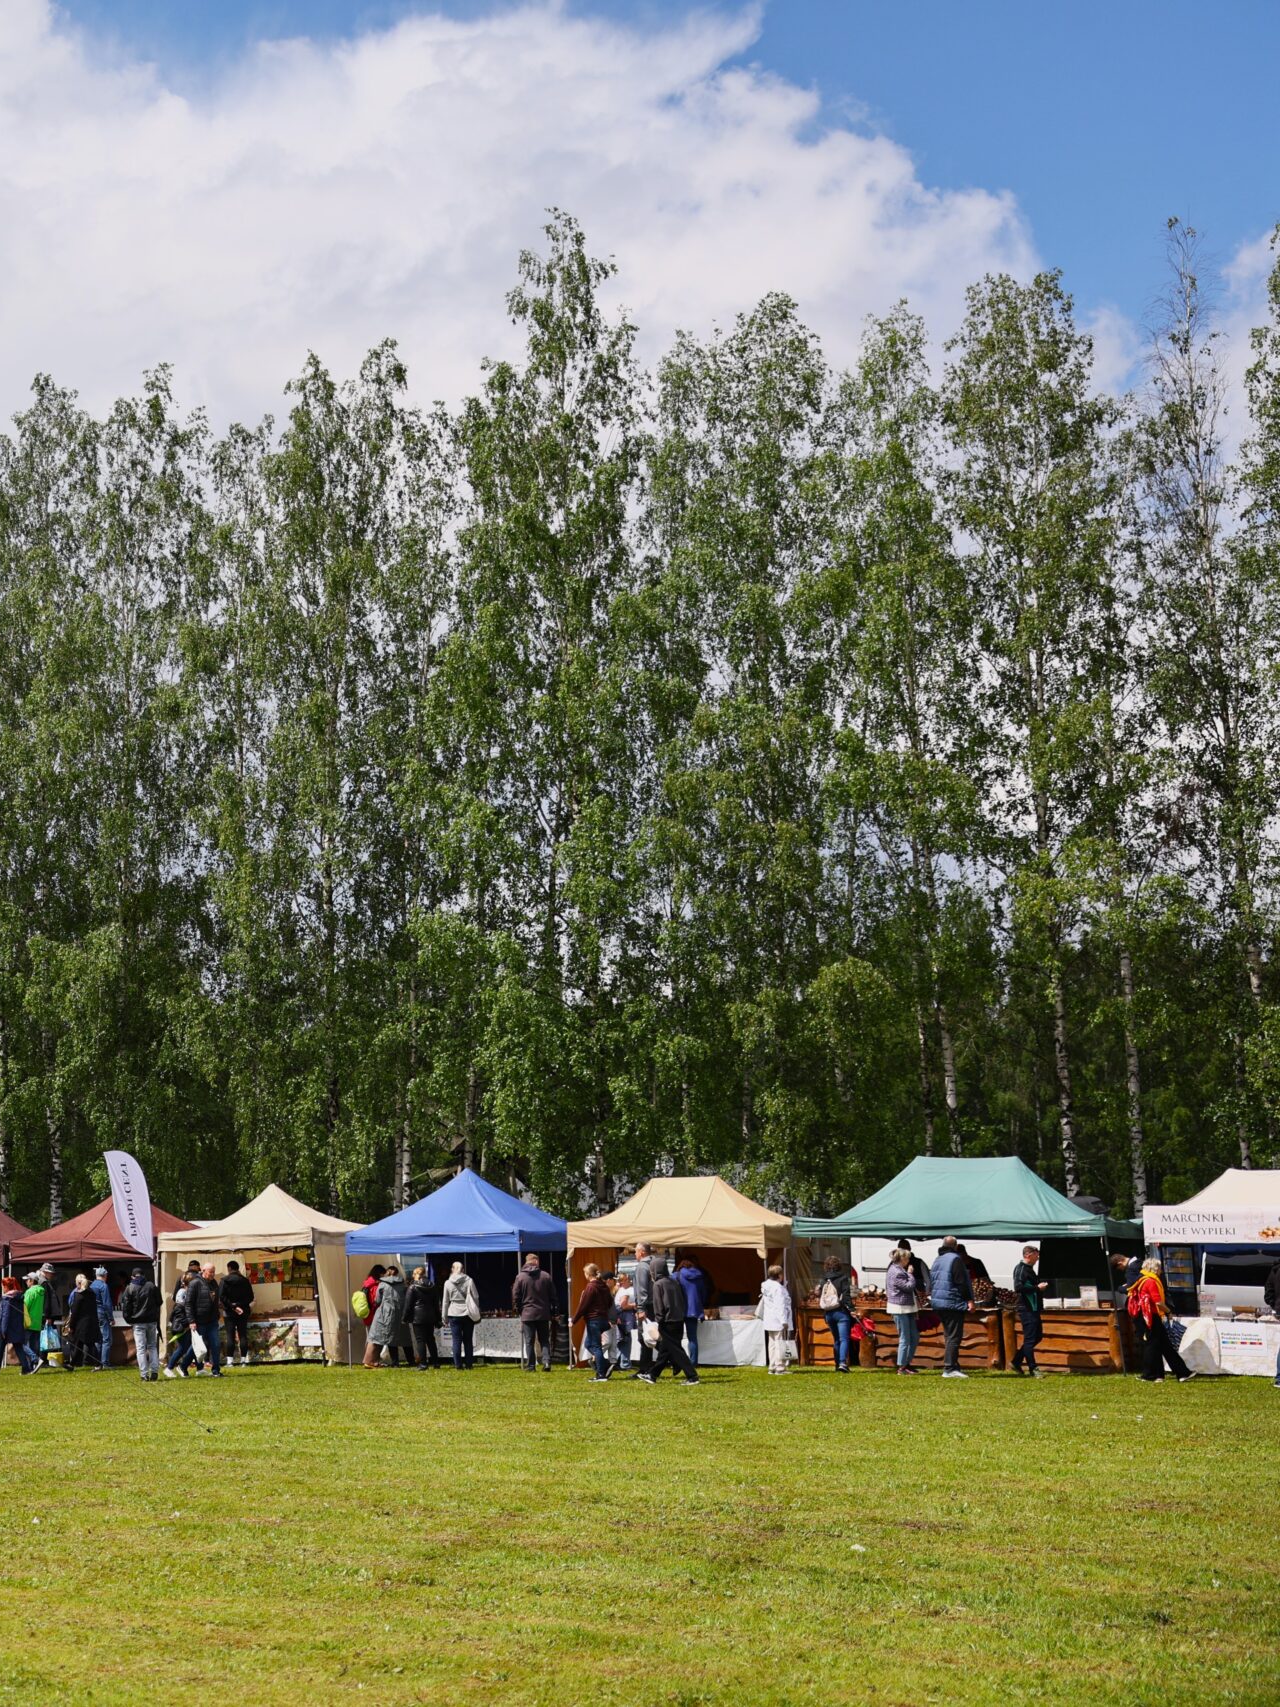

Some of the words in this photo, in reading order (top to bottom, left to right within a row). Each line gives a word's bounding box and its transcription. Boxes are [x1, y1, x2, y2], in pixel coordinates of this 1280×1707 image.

[1161, 1213, 1224, 1223] MARCINKI
[1152, 1227, 1156, 1235] I
[1159, 1227, 1189, 1235] INNE
[1190, 1227, 1236, 1235] WYPIEKI
